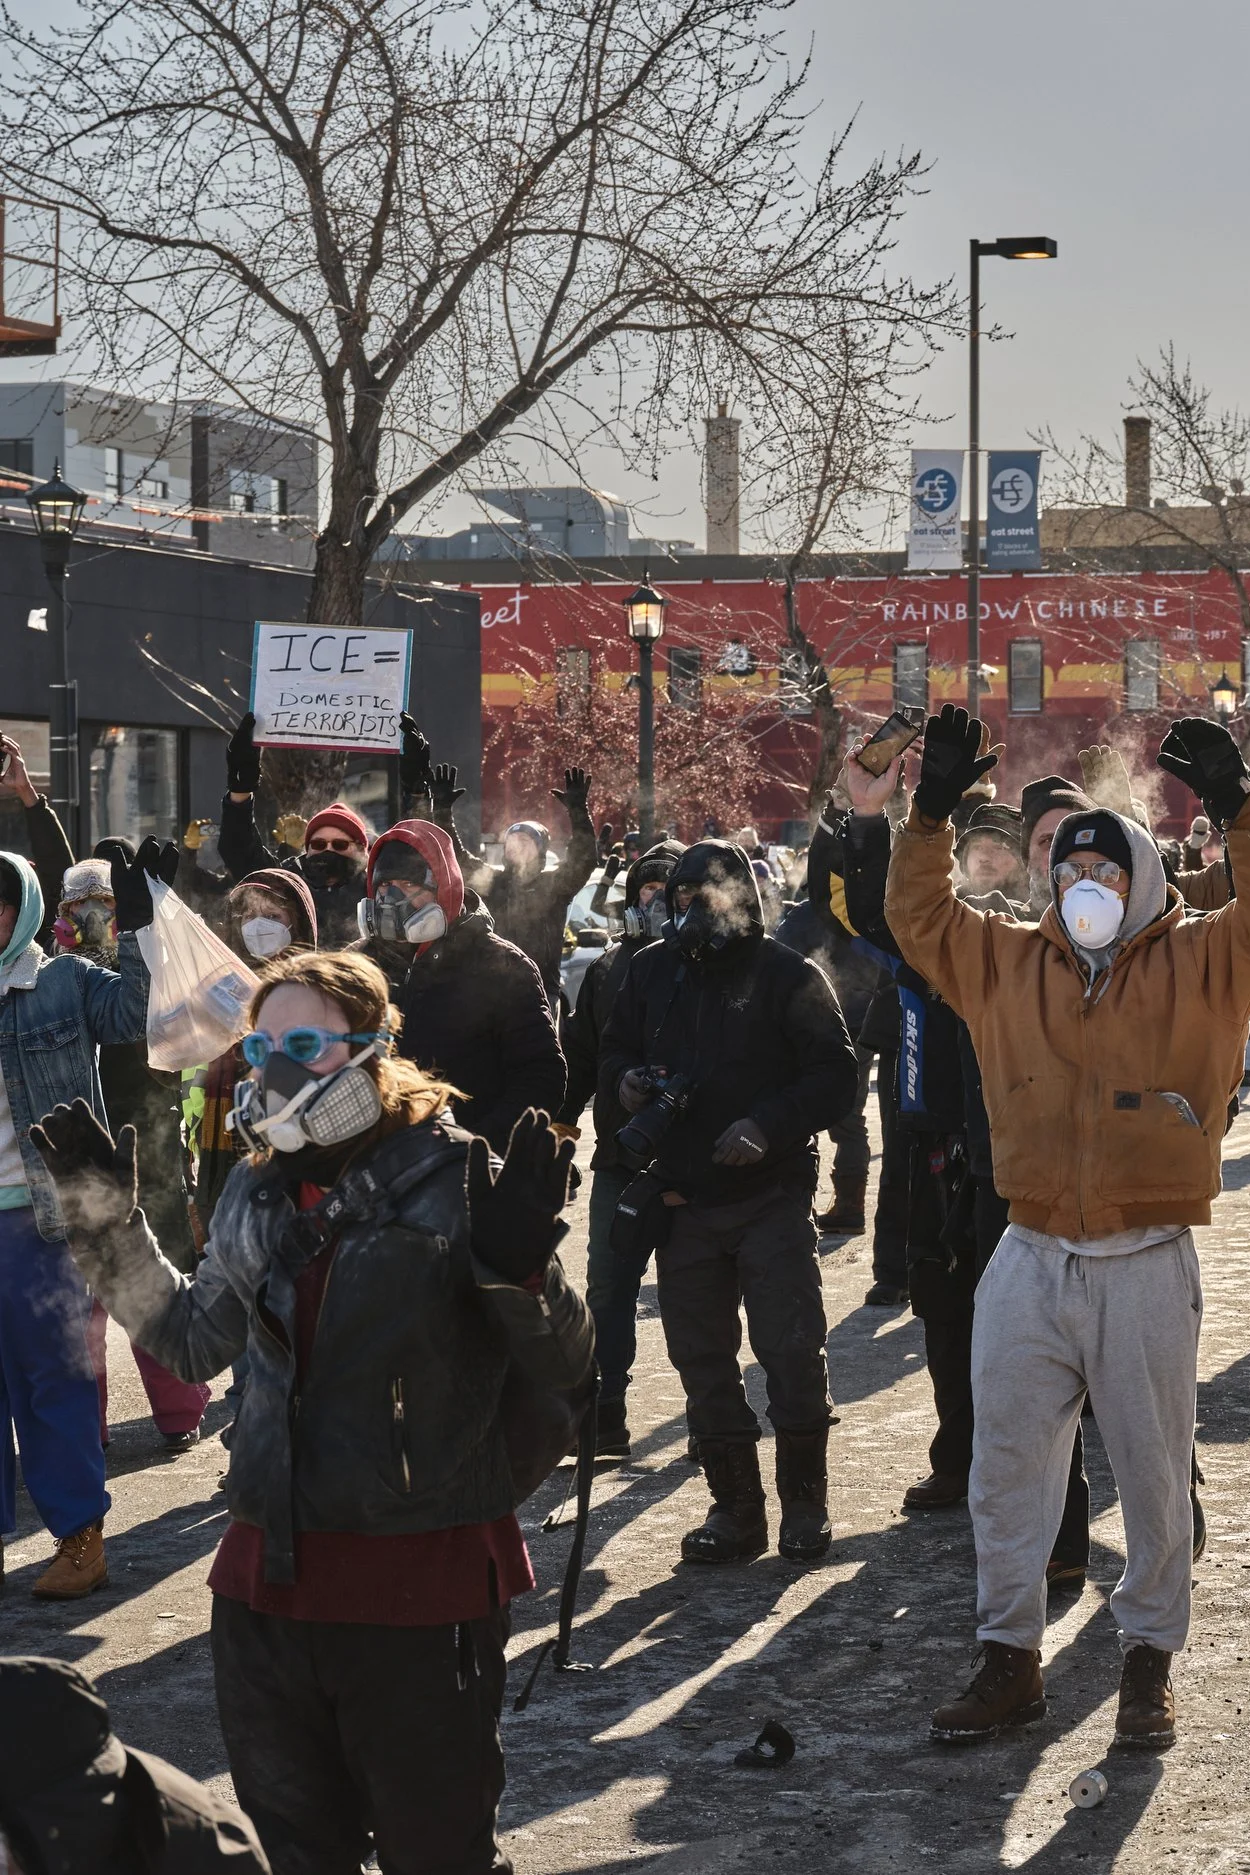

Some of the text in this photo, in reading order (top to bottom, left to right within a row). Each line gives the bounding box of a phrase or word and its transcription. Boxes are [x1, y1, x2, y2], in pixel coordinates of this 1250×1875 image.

[991, 527, 1035, 537] eat street
[884, 599, 1168, 621] RAINBOW CHINESE
[270, 634, 367, 674] ICE
[280, 692, 394, 711] DOMESTIC
[271, 711, 398, 738] TERRORISTS
